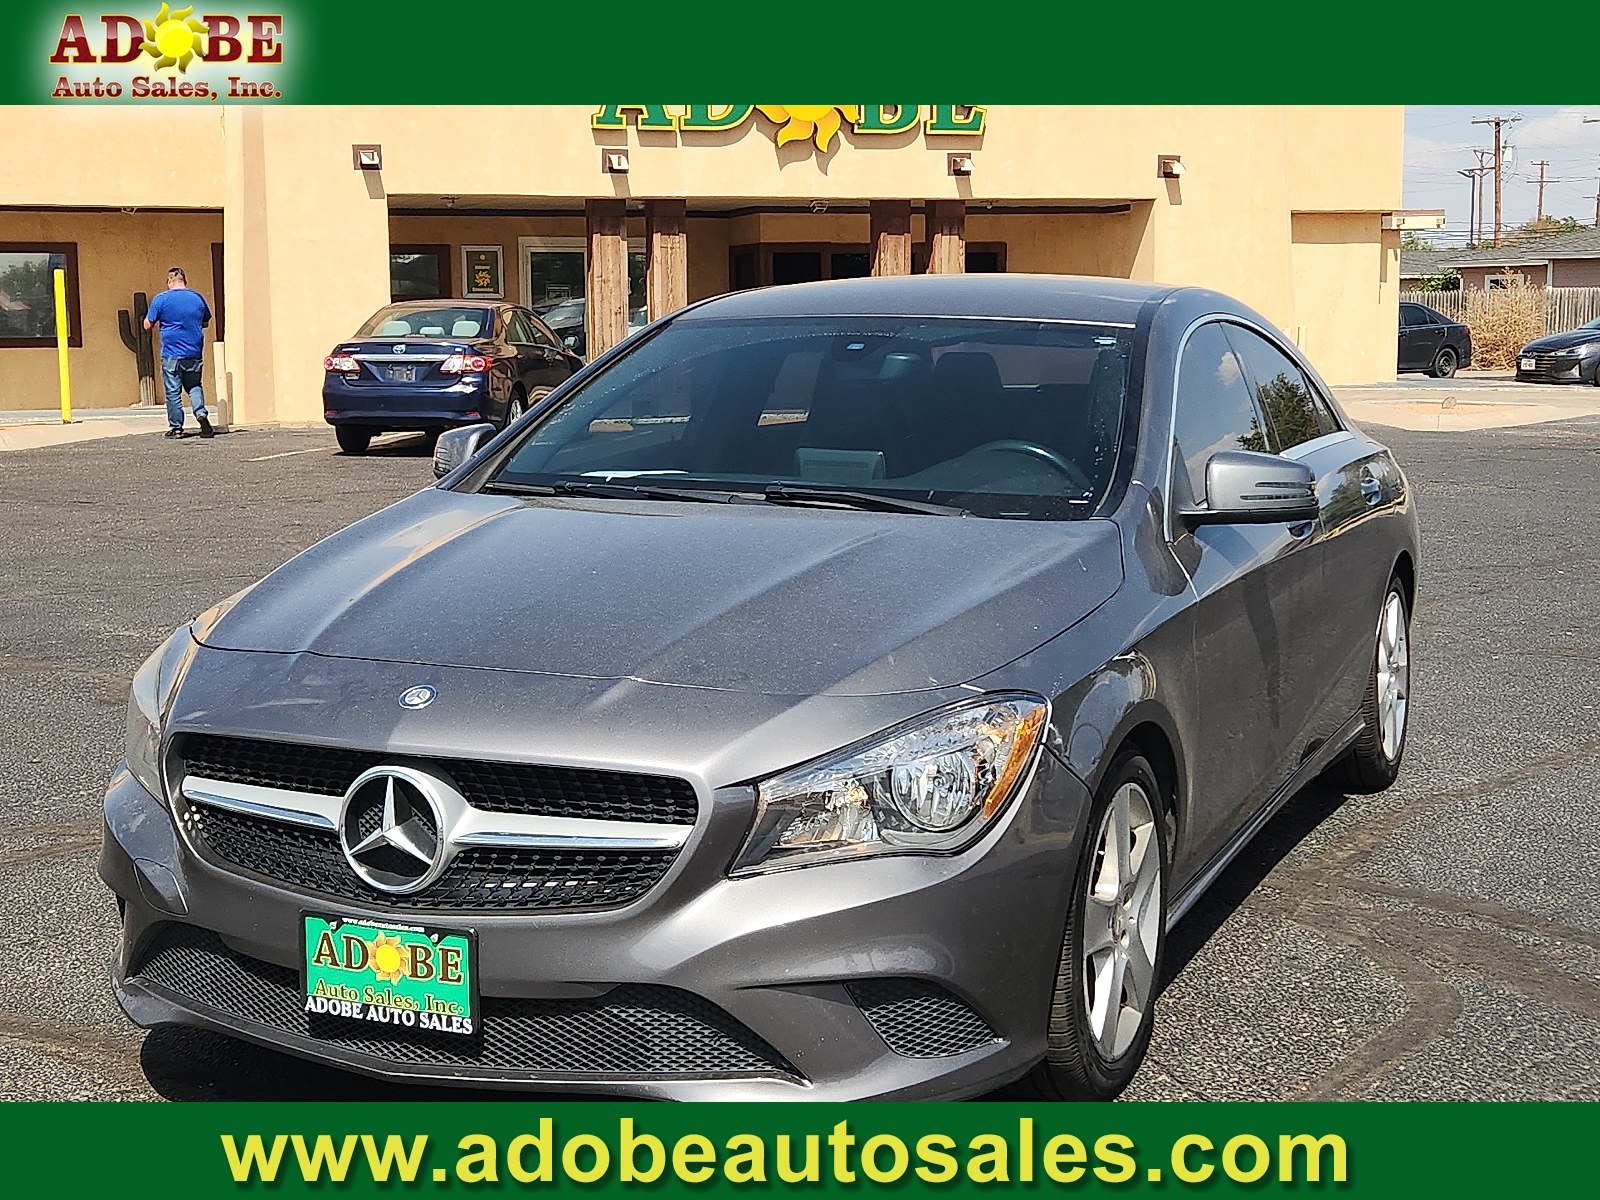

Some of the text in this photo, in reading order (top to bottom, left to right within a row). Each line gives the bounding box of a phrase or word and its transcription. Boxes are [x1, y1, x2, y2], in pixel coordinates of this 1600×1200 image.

[315, 979, 464, 1014] Auto Sales, Inc.
[304, 996, 473, 1034] ADOBE AUTO SALES
